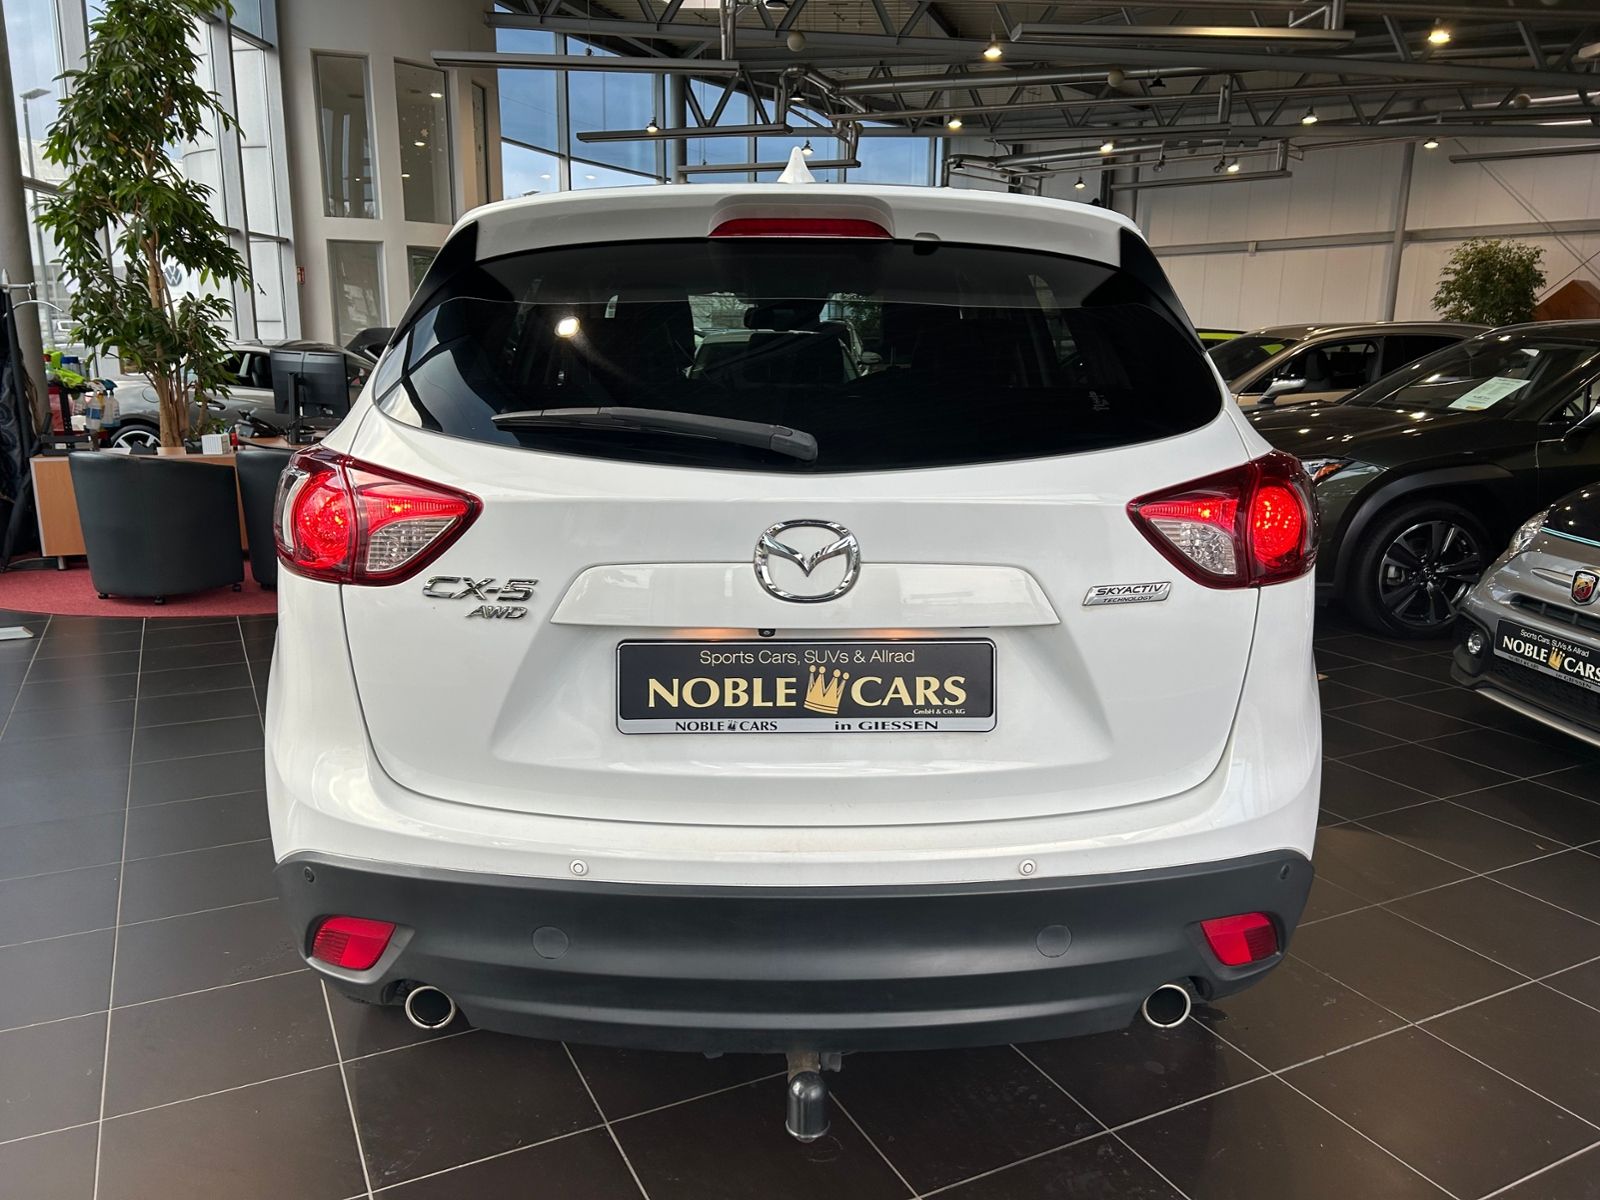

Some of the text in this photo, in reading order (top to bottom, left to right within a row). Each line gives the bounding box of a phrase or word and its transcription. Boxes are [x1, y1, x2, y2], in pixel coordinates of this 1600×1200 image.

[422, 576, 539, 601] CX-5
[1095, 584, 1163, 596] SKYACTIV
[1103, 595, 1154, 603] TECHNOLOGY
[465, 605, 528, 619] AWD
[1502, 635, 1548, 663] NOBLE
[1520, 629, 1537, 640] Sports
[1551, 639, 1566, 651] SUVs
[1572, 646, 1589, 658] Allrad
[700, 650, 915, 666] Sports Cars, SUVs & Allrad
[648, 676, 967, 708] NOBLE CARS
[675, 721, 938, 731] NOBLE CARS in GIESSEN
